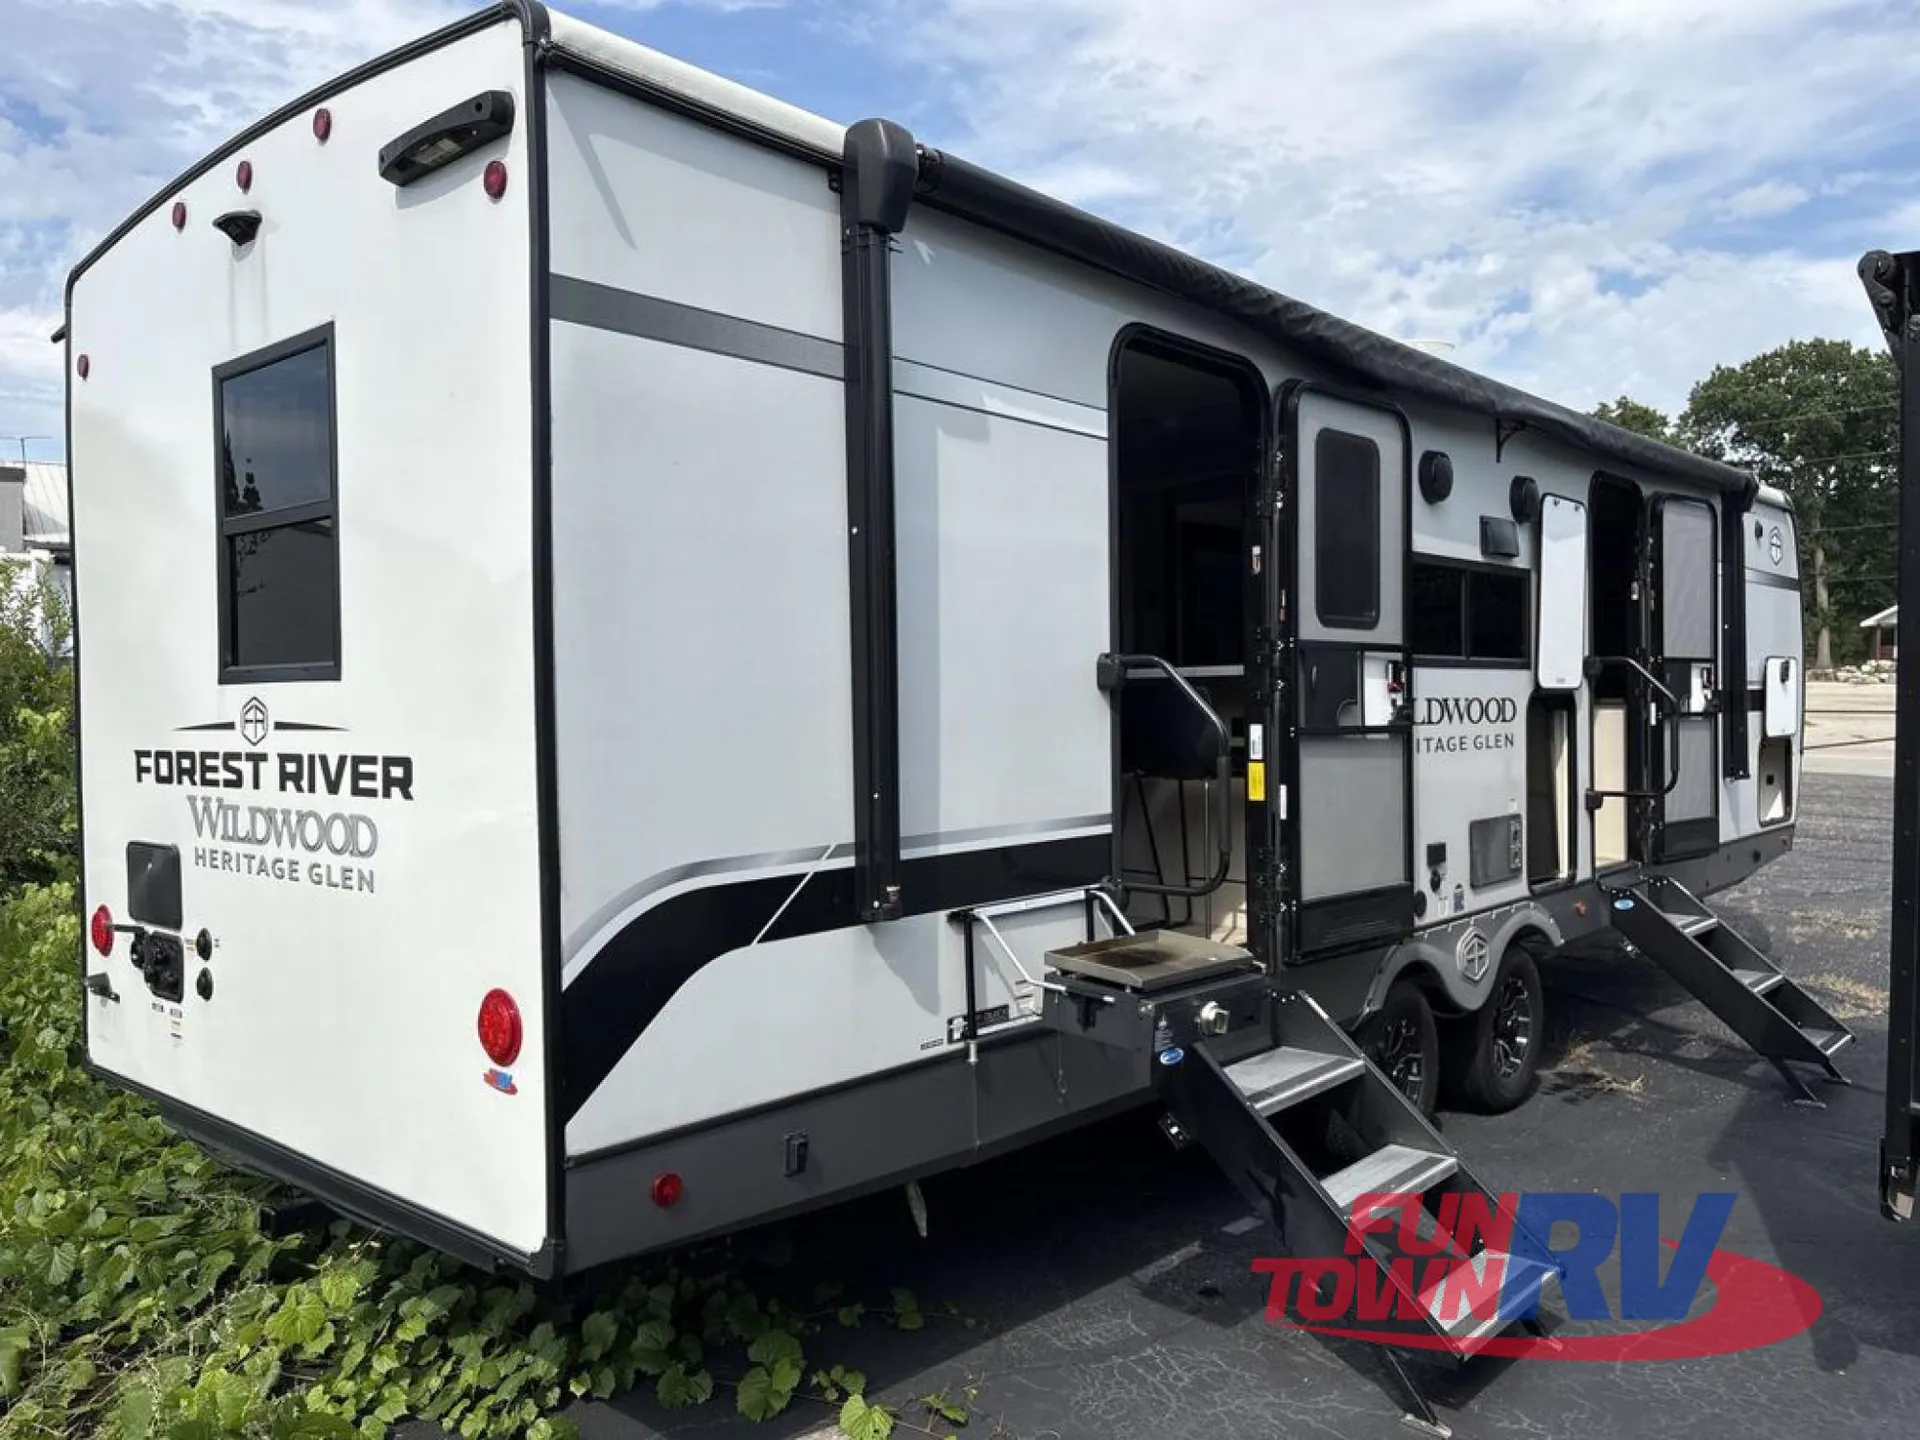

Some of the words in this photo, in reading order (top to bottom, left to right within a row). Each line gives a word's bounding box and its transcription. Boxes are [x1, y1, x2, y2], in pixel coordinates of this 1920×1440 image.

[1412, 696, 1517, 726] LDWOOD
[1416, 736, 1467, 754] ITAGE
[1473, 732, 1514, 751] GLEN
[134, 749, 268, 790] FOREST
[277, 752, 415, 801] RIVER
[186, 794, 379, 859] WILDWOOD
[194, 846, 301, 882] HERITAGE
[307, 862, 376, 894] GLEN
